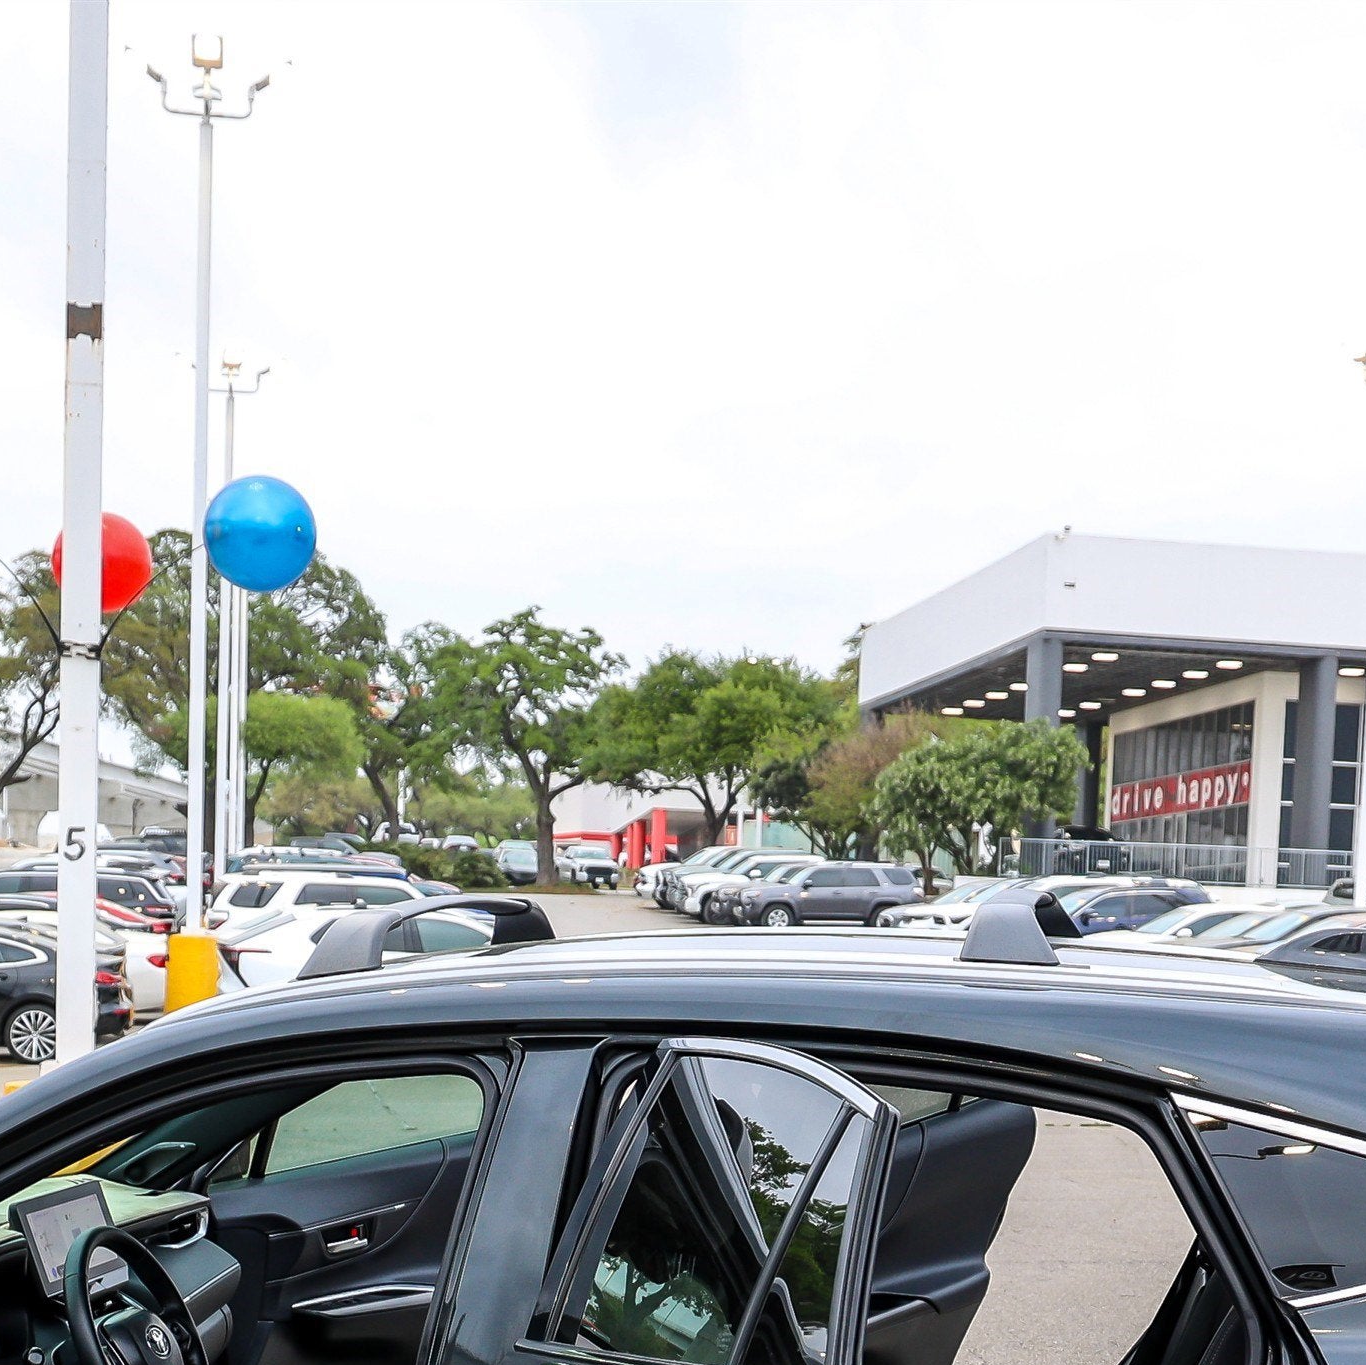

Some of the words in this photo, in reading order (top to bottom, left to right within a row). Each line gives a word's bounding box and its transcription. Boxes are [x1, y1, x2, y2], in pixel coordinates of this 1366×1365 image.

[1112, 784, 1163, 816] drive
[1177, 772, 1238, 809] happy
[63, 826, 86, 861] 5
